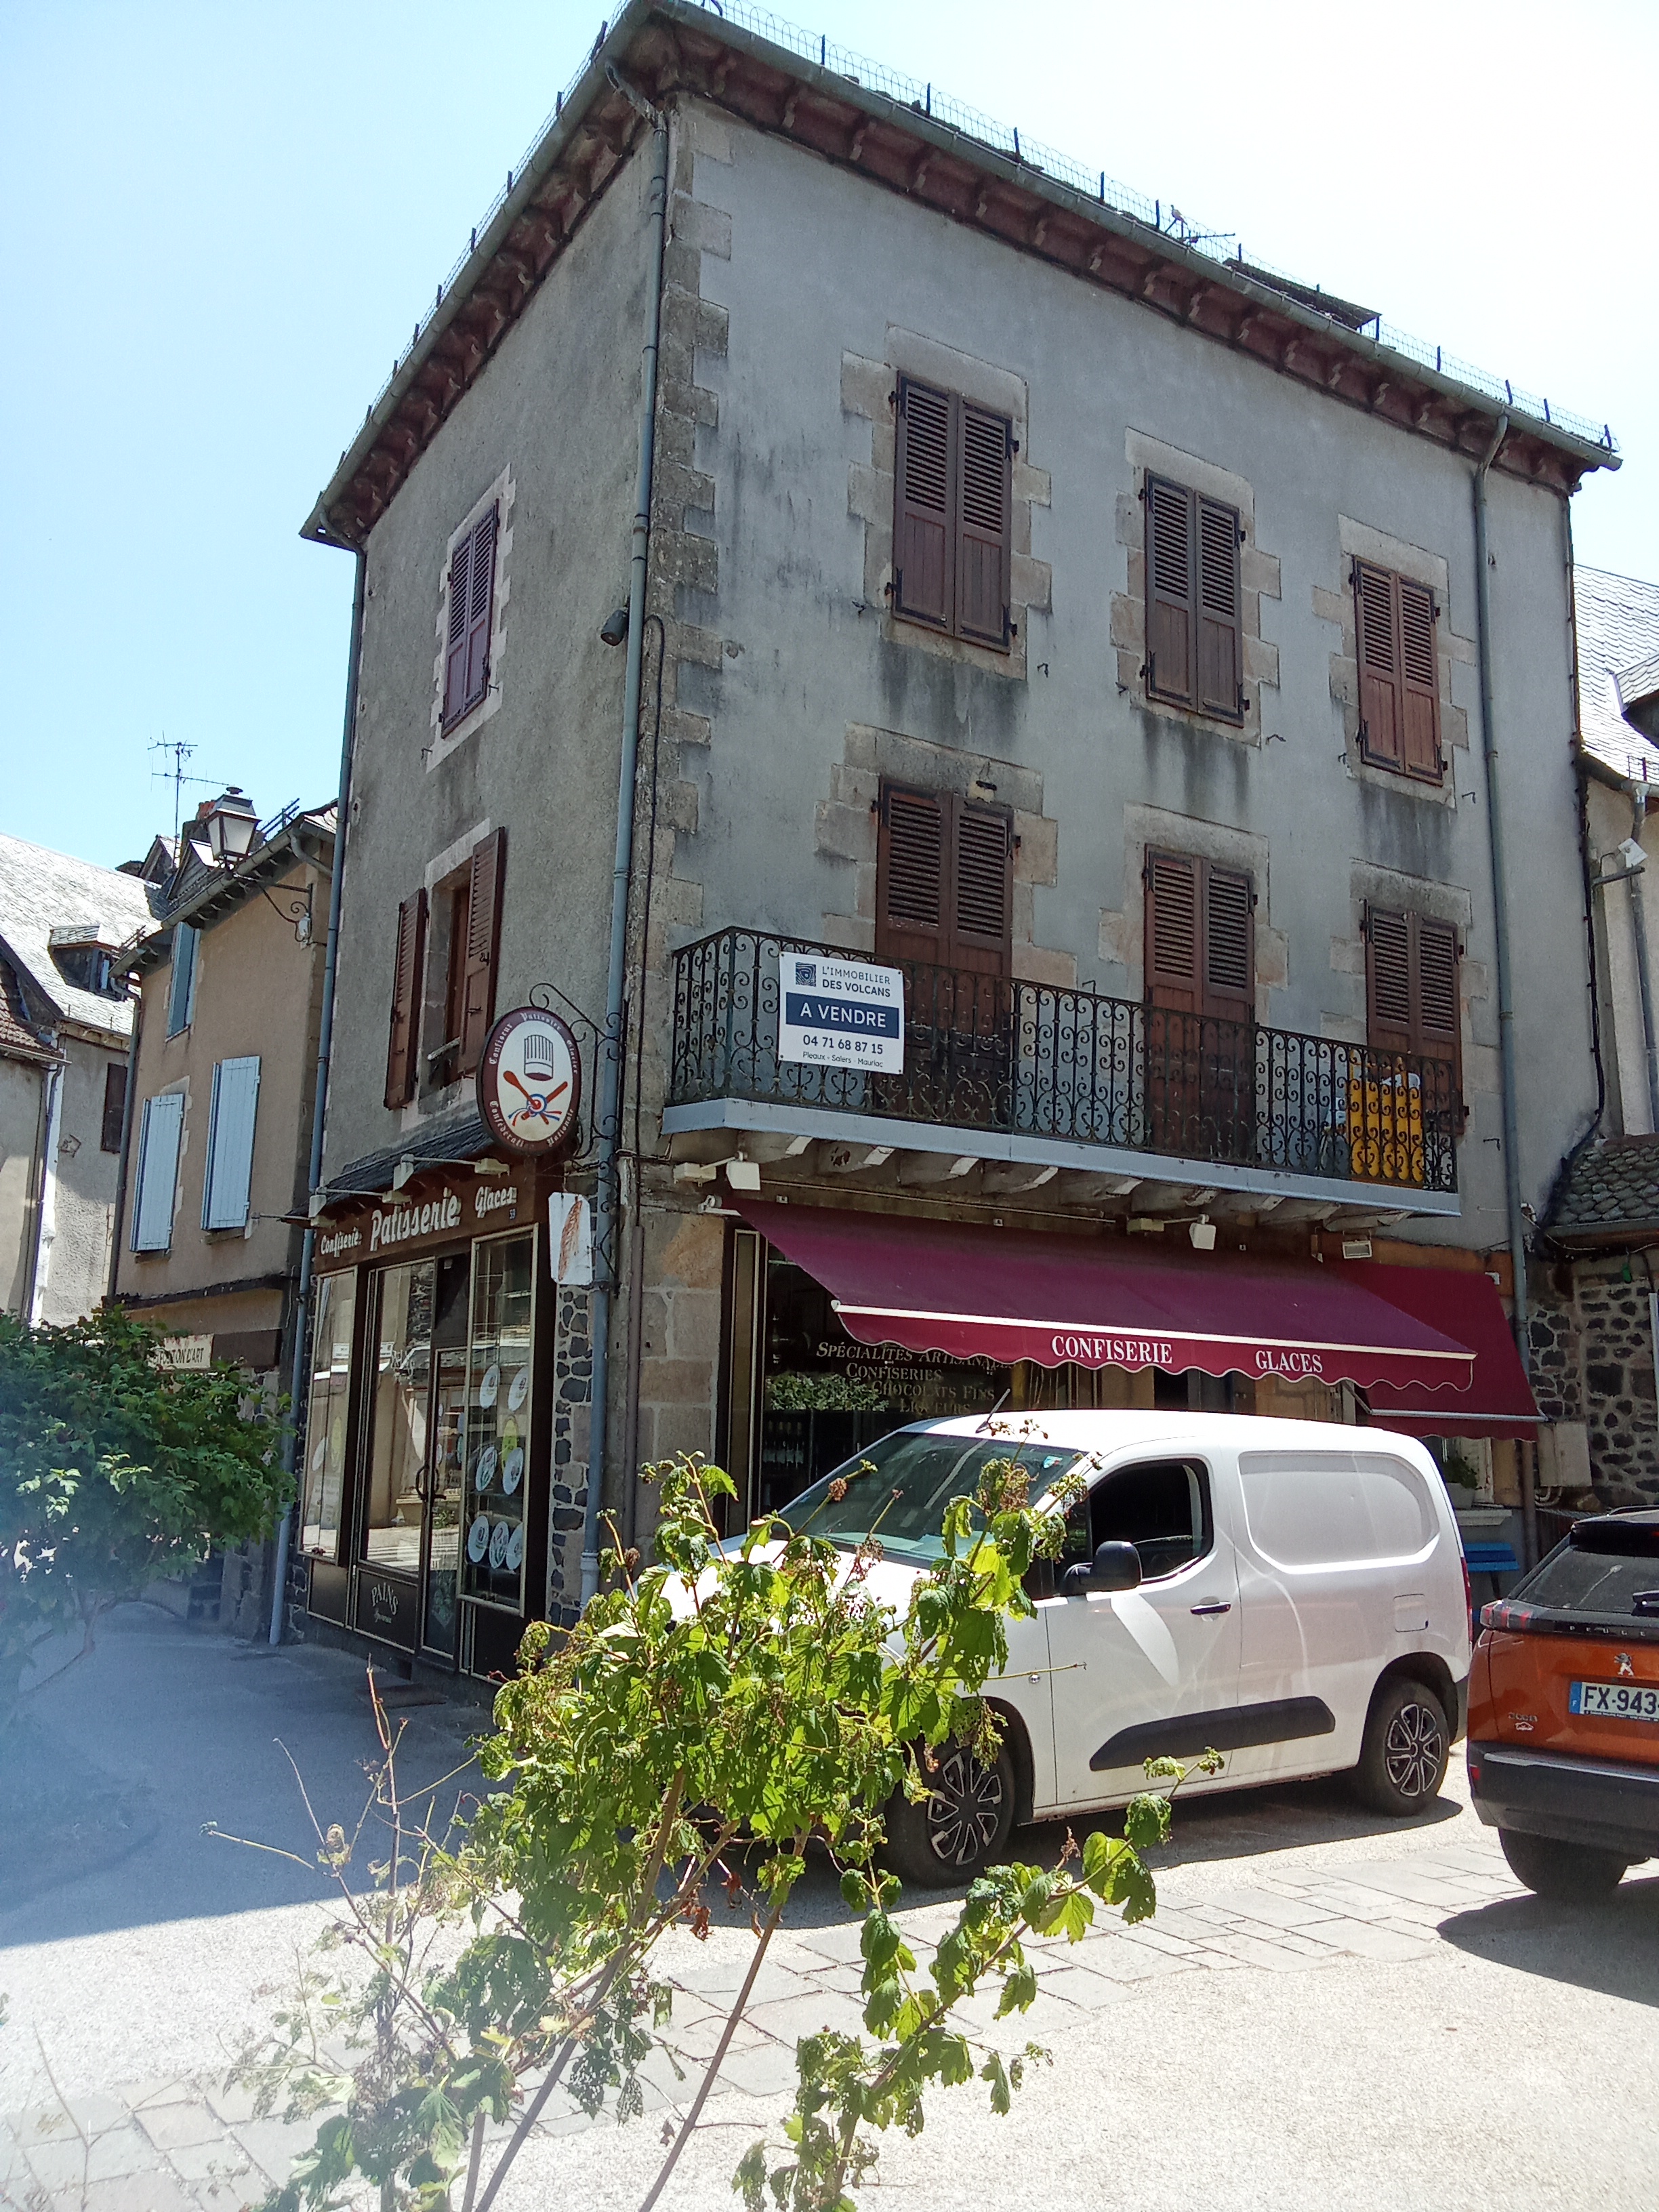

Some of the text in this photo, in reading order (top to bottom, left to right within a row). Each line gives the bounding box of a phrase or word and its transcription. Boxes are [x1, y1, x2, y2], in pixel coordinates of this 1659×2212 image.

[822, 966, 890, 985] L'IMMOBILIER
[822, 979, 890, 998] DES VOLCANS
[800, 1002, 886, 1028] A VENDRE
[802, 1034, 884, 1054] 04 71 68 87 15
[802, 1051, 883, 1068] Pleaux Salers Mauriac
[321, 1226, 363, 1257] Confiserie
[475, 1186, 517, 1218] Glaces
[1052, 1335, 1323, 1373] CONFISERIE GLACES
[846, 1362, 943, 1380] CONFISERIES
[963, 1385, 994, 1400] FINS
[371, 1582, 398, 1616] PAINS
